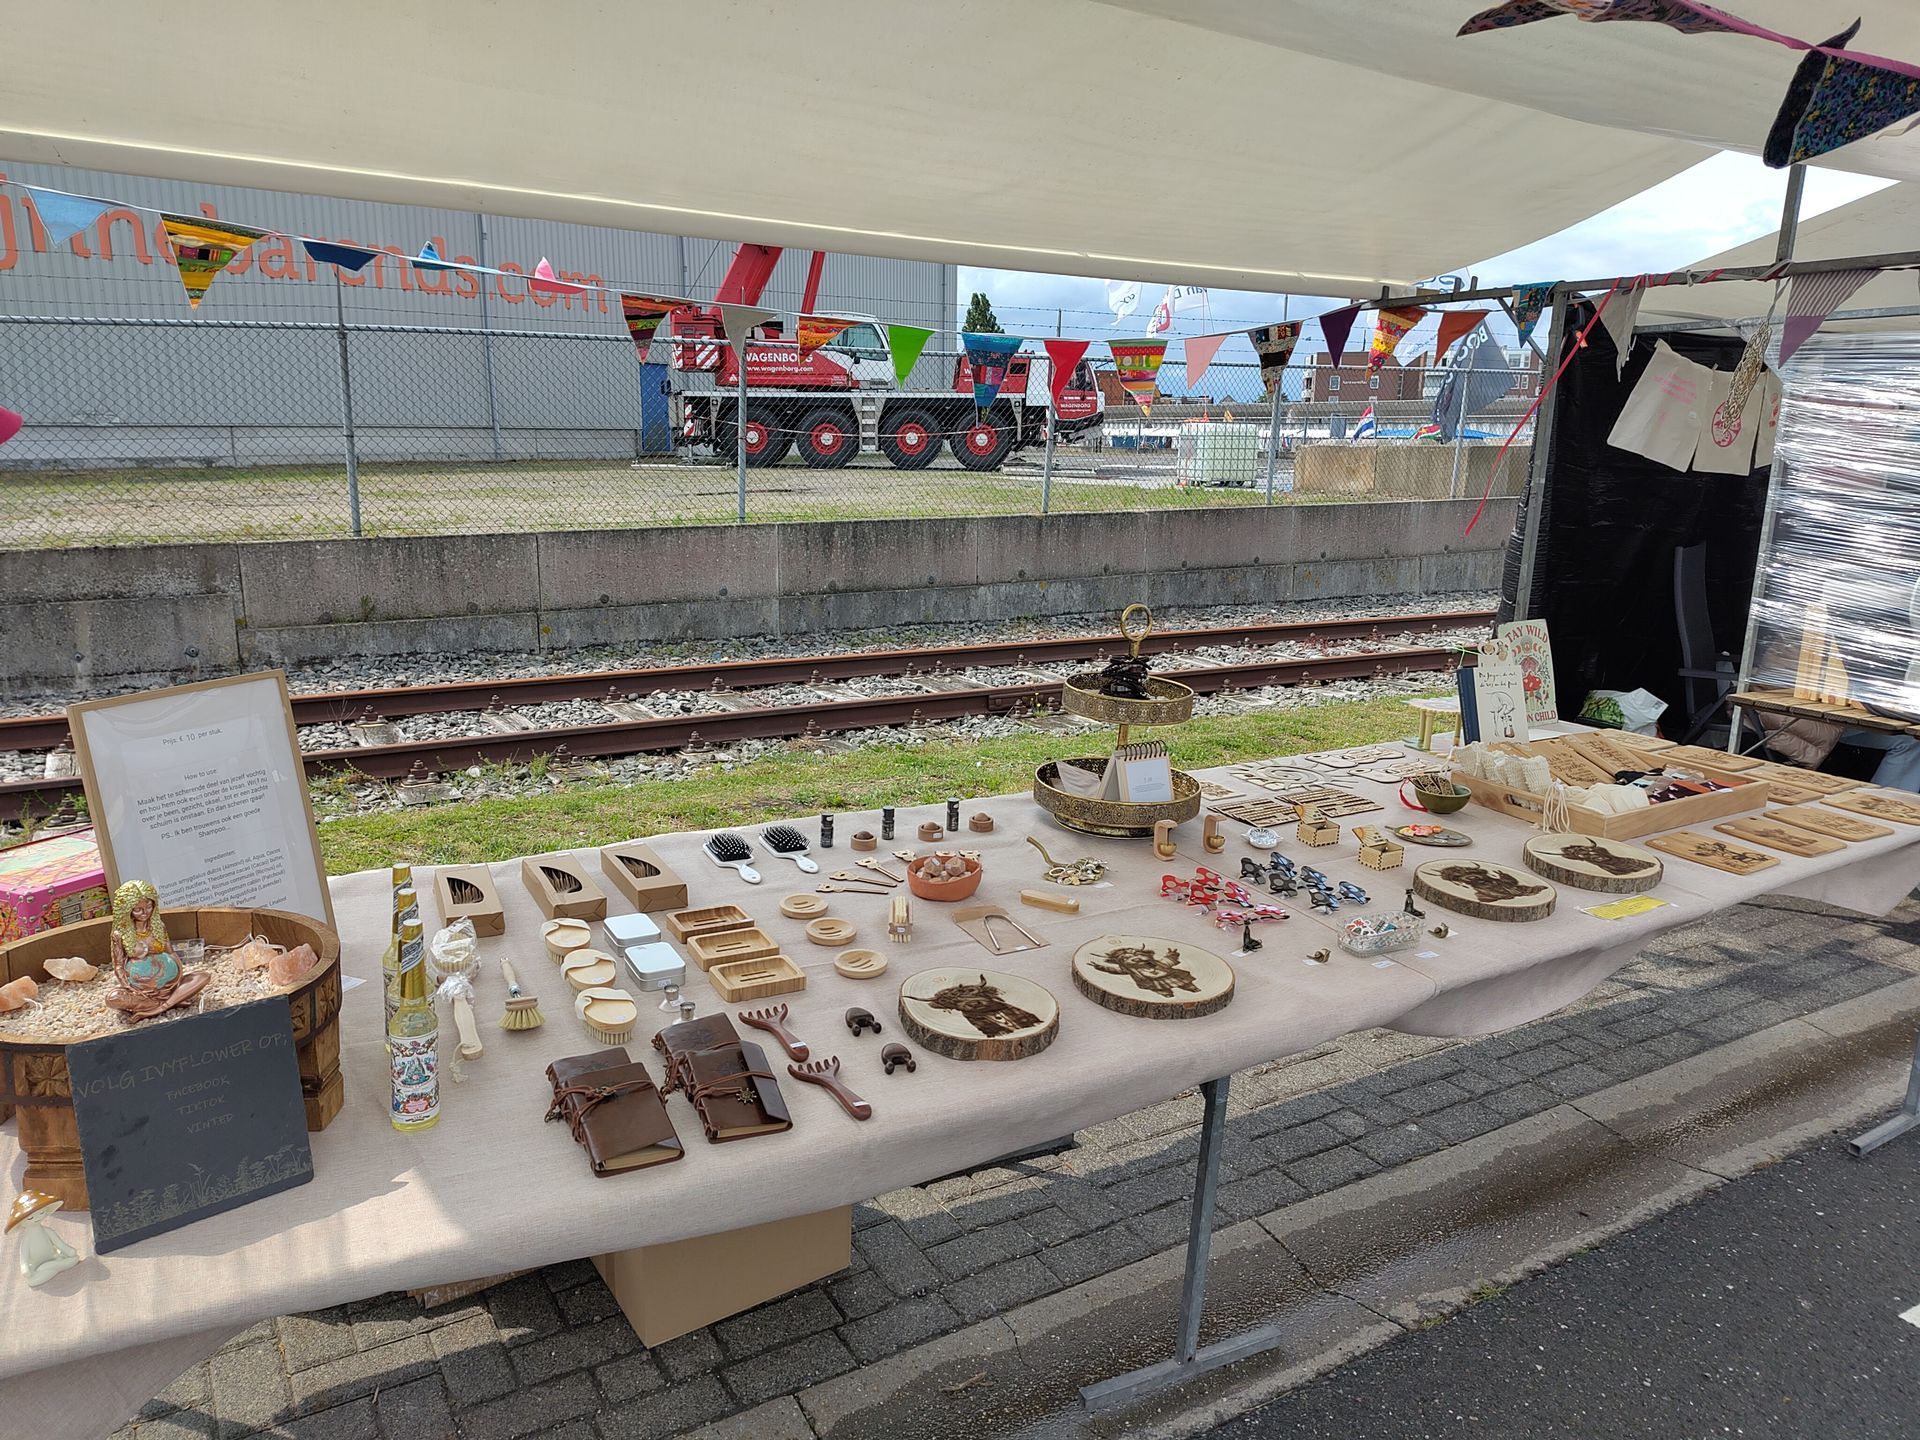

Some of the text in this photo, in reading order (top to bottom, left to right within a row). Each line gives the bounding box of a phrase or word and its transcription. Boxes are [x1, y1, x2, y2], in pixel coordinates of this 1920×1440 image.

[1505, 625, 1549, 645] TAY WILD
[1534, 710, 1557, 722] CHILD
[186, 732, 195, 741] 10
[137, 797, 154, 805] Maak
[175, 785, 205, 796] scherende
[206, 780, 218, 788] deel
[230, 773, 245, 784] jezelf
[246, 770, 266, 778] vochtig
[176, 797, 188, 805] ook
[203, 789, 220, 798] onder
[141, 815, 155, 823] over
[251, 785, 268, 793] zachte
[150, 819, 172, 829] schuim
[227, 798, 249, 808] scheren
[193, 819, 220, 830] trouwens
[243, 808, 260, 817] goede
[77, 1069, 136, 1099] VOLG
[139, 1038, 253, 1083] IVYFLOWER
[165, 1074, 231, 1101] FACEBOOK
[175, 1094, 226, 1114] TIKTOK
[186, 1113, 234, 1134] VINTED
